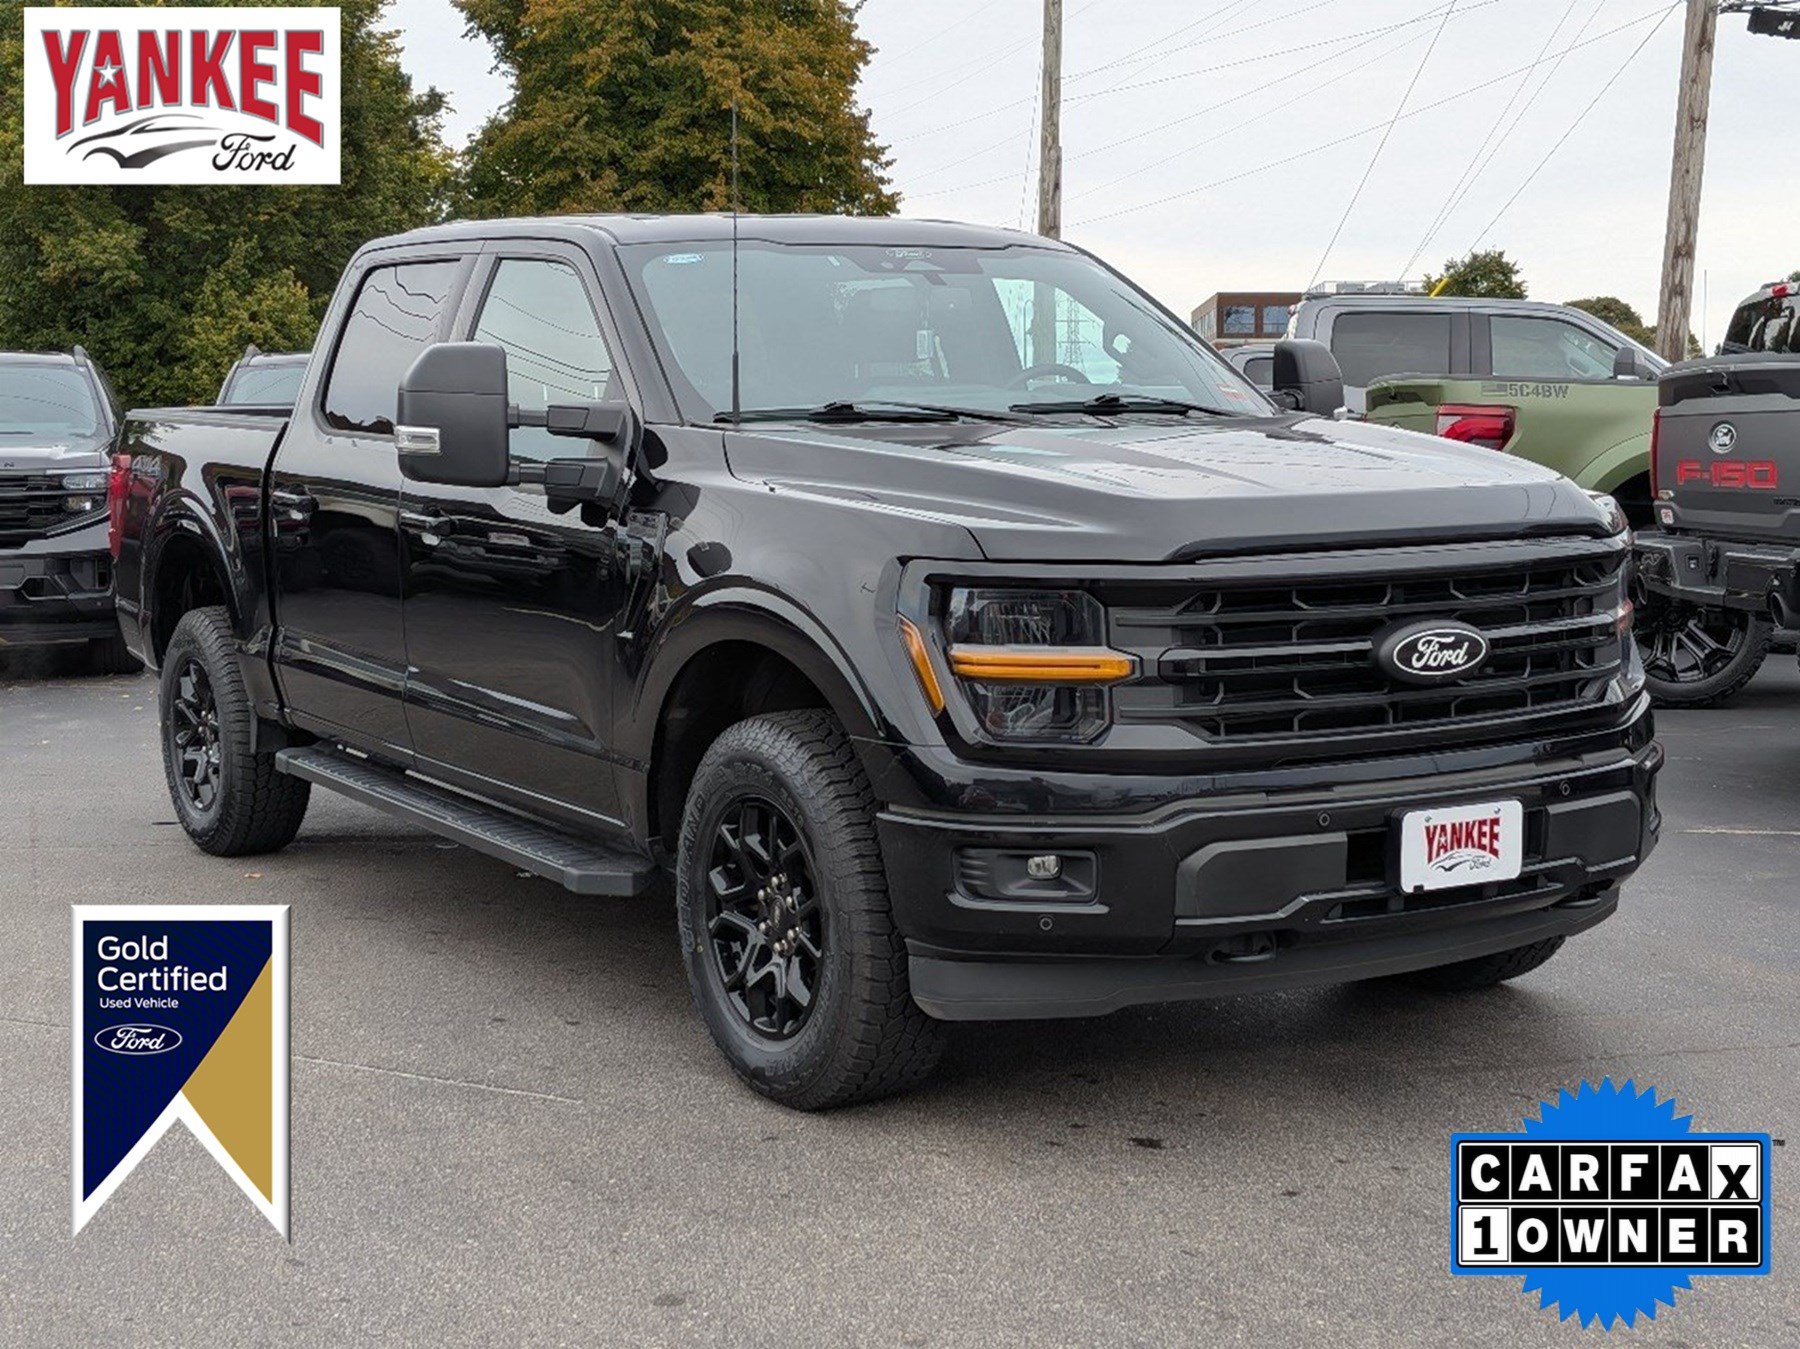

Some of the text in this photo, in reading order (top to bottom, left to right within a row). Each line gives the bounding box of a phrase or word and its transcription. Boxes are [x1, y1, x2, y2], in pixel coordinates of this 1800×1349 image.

[1677, 459, 1778, 490] F-150
[1411, 636, 1469, 668] Ford
[1425, 817, 1500, 864] YANKEE
